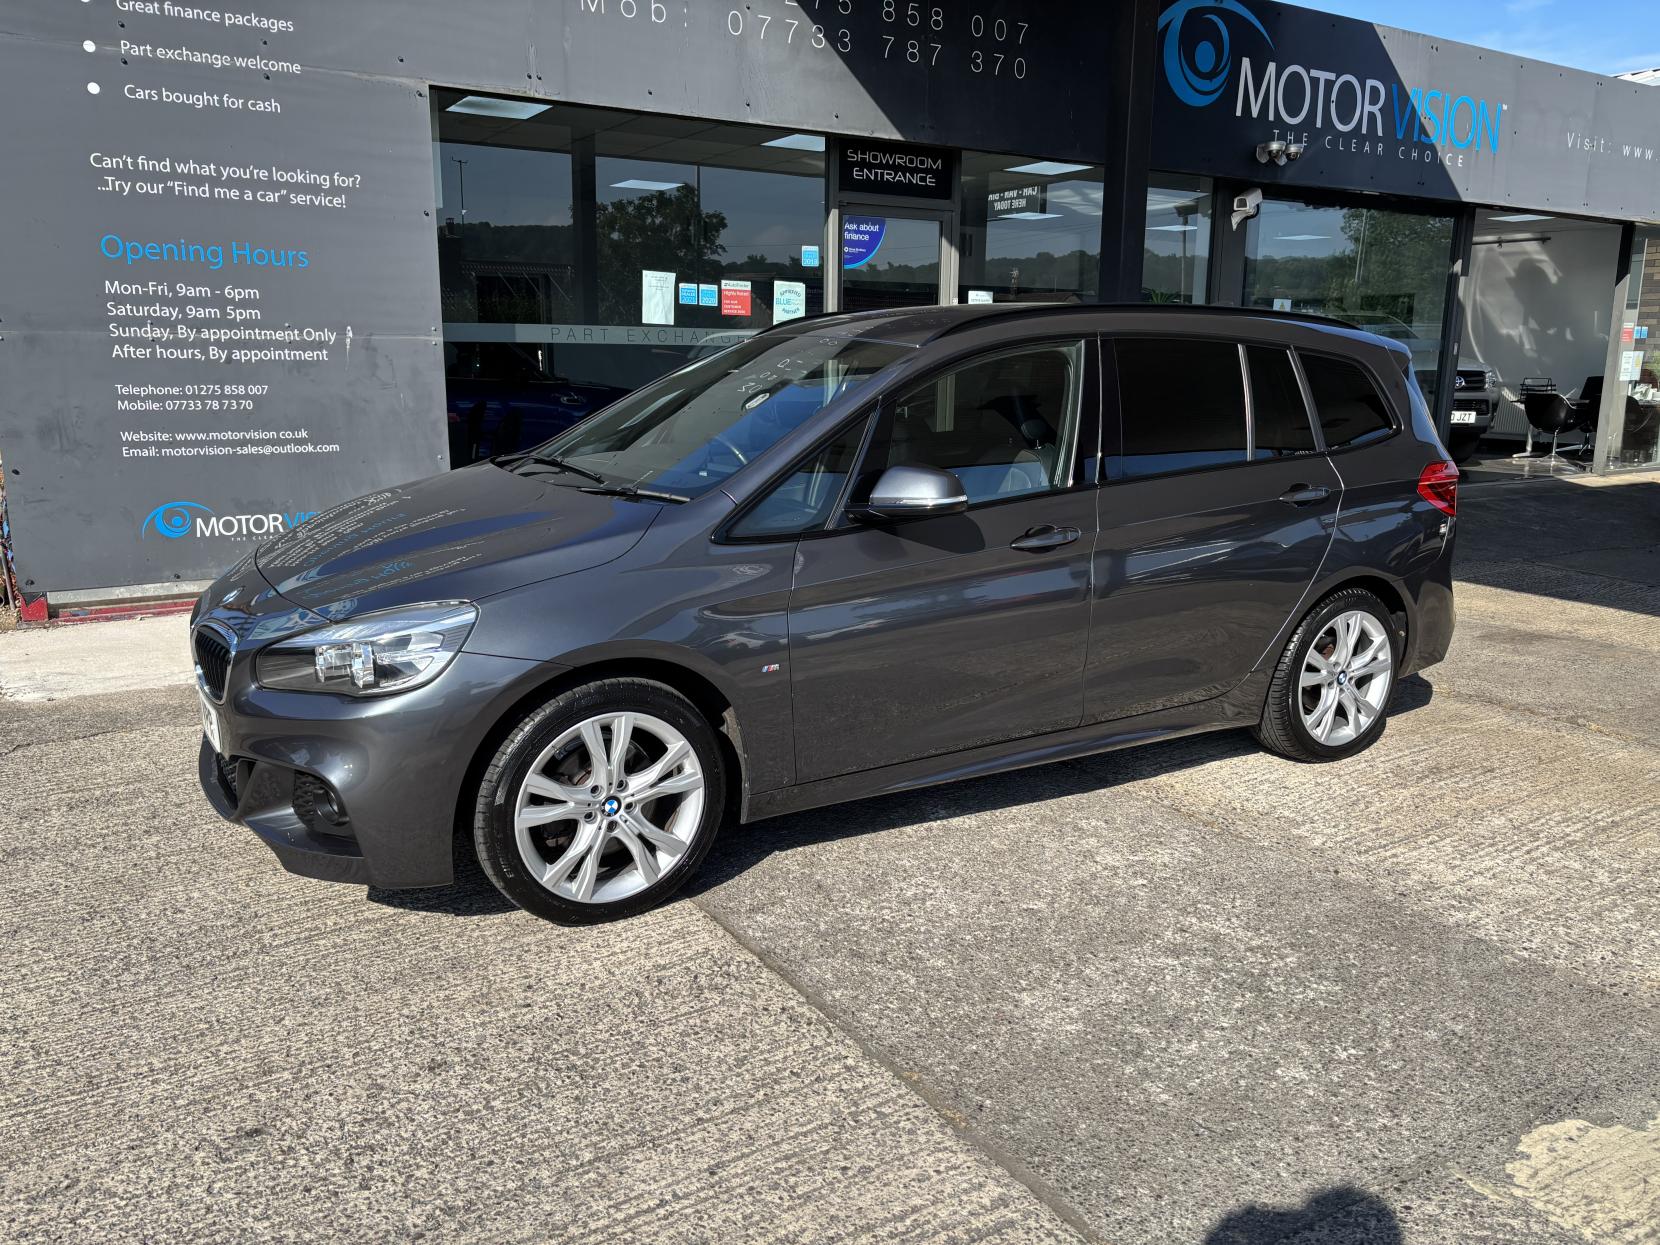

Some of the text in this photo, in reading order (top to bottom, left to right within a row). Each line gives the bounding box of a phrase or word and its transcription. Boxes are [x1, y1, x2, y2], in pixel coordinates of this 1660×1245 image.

[116, 0, 294, 33] Great finance packages
[882, 0, 944, 31] 858
[971, 14, 1029, 45] 007
[728, 10, 852, 53] 07733
[882, 35, 942, 67] 787
[970, 50, 1026, 79] 370
[120, 40, 301, 73] Part exchange welcome
[124, 85, 280, 113] Cars bought for cash
[1273, 130, 1463, 167] THE CLEAR CHOICE
[1567, 132, 1612, 153] Visit:
[847, 149, 942, 170] SHOWROOM
[138, 156, 170, 173] find
[175, 160, 216, 176] what
[273, 166, 329, 189] looking
[334, 172, 361, 188] for?
[853, 167, 936, 186] ENTRANCE
[136, 181, 164, 194] our
[215, 187, 239, 199] me
[243, 190, 253, 200] a
[289, 194, 346, 208] service!
[844, 232, 869, 240] finance
[860, 222, 879, 231] about
[101, 234, 308, 269] Opening Hours
[105, 281, 172, 298] Mon-Fri,
[177, 284, 210, 297] 9am
[225, 286, 259, 300] 6pm
[107, 302, 261, 322] Saturday, 9am 5pm
[109, 324, 336, 344] Sunday, By appointment Only
[552, 328, 608, 342] PART
[112, 345, 328, 362] After hours, By appointment
[115, 384, 268, 397] Telephone: 01275 858 007
[118, 400, 163, 411] Mobile:
[166, 401, 202, 411] 07733
[1456, 412, 1471, 422] JZT
[121, 432, 172, 441] Website:
[122, 443, 339, 457] Email: motorvision-sales@outlook.com
